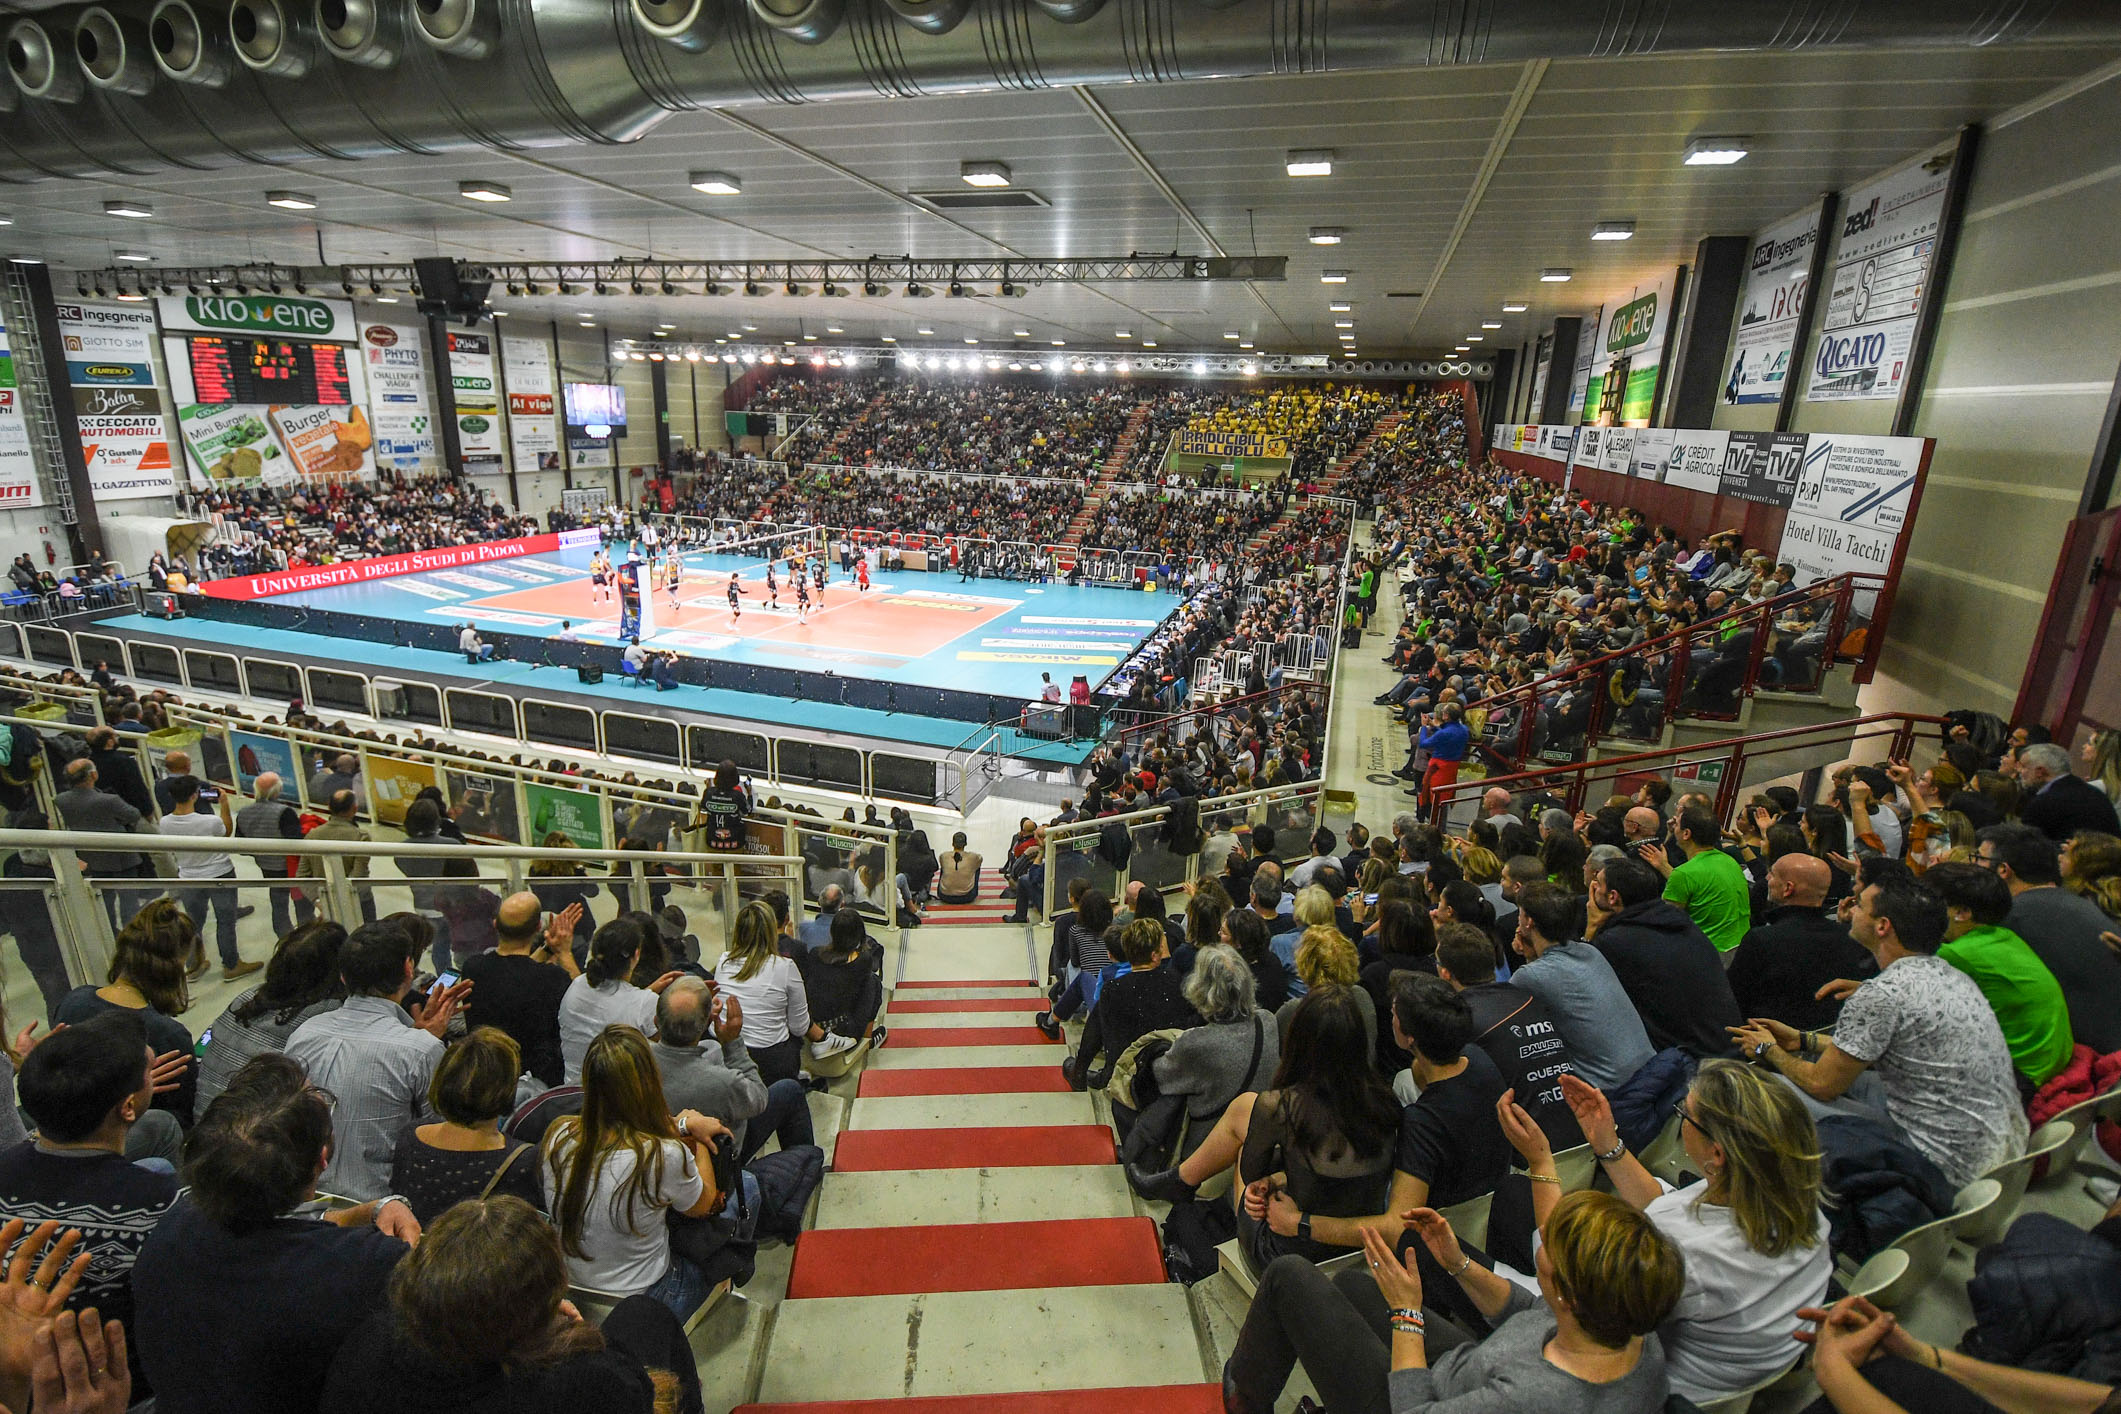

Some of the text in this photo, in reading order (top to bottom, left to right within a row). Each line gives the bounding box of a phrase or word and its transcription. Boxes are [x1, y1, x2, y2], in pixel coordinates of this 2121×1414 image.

[1754, 226, 1817, 267] ARC ingegneria
[83, 309, 153, 323] ingegneria
[83, 337, 144, 348] GIOTTO SIM
[384, 348, 418, 360] PHYTO
[1816, 332, 1885, 377] RIGATO
[374, 371, 420, 380] CHALLENGER
[385, 379, 410, 388] VIAGGI
[97, 418, 156, 427] CECCATO
[190, 413, 249, 441] Mini Burger
[282, 407, 331, 434] Burger
[80, 427, 161, 437] AUTOMOBILI
[1182, 431, 1264, 446] IRRIDUCIBILI
[108, 449, 143, 457] Gusella
[1182, 442, 1263, 457] GIALLOBLU
[1688, 443, 1715, 460] CRÉDIT
[1853, 448, 1885, 456] RIVESTIMENTO
[1830, 455, 1853, 463] COPERTURE
[1874, 459, 1901, 467] INDUSTRIALI
[1684, 461, 1722, 477] AGRICOLE
[1828, 463, 1851, 471] RIMOZIONE
[1854, 465, 1875, 474] BONIFICA
[102, 479, 172, 489] GAZZETTINO
[1776, 484, 1794, 495] NEWS
[1798, 482, 1819, 502] P&P
[1786, 519, 1888, 563] Hotel Villa Tacchi
[252, 543, 525, 595] UNIVERSITÀ DEGLI STUDI DI PADOVA
[1796, 559, 1823, 577] Ristorante
[715, 814, 724, 828] 14
[838, 841, 854, 849] USCITA
